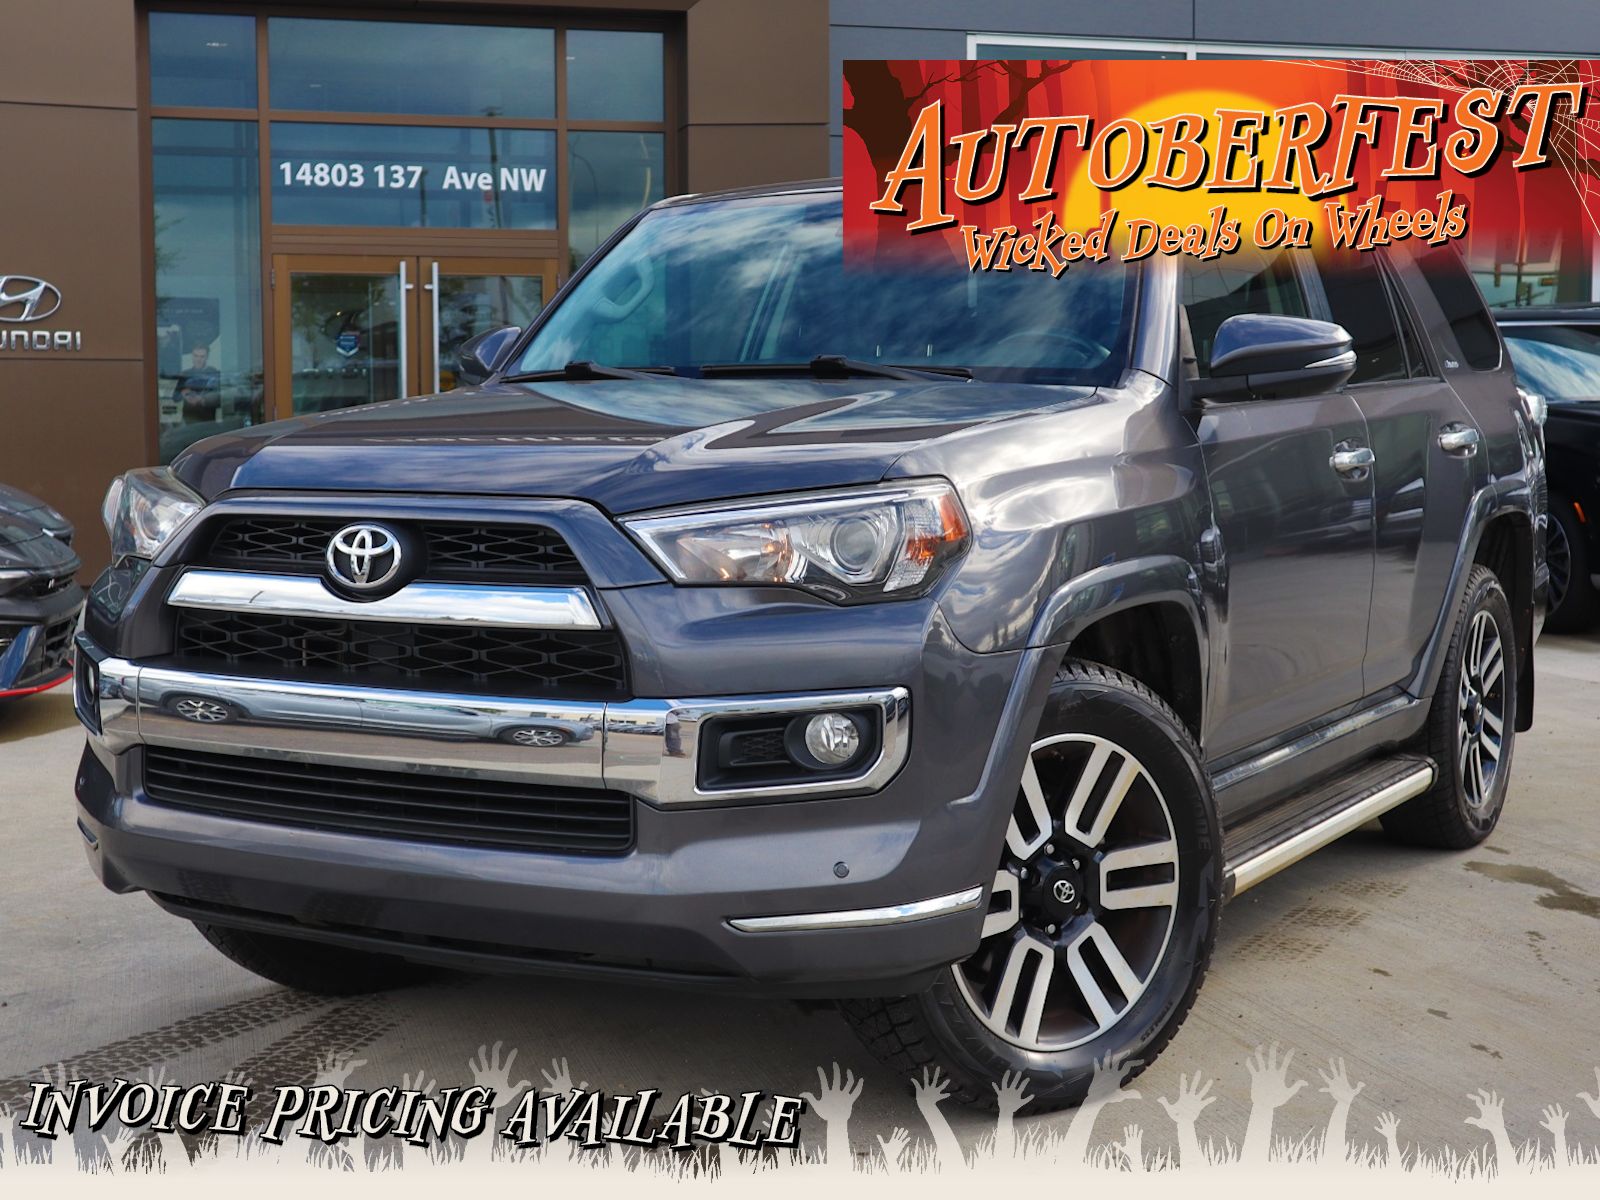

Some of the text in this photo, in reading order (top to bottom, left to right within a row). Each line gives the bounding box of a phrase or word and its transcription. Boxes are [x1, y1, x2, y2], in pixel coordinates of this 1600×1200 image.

[279, 161, 547, 192] 14803 137 Ave NW
